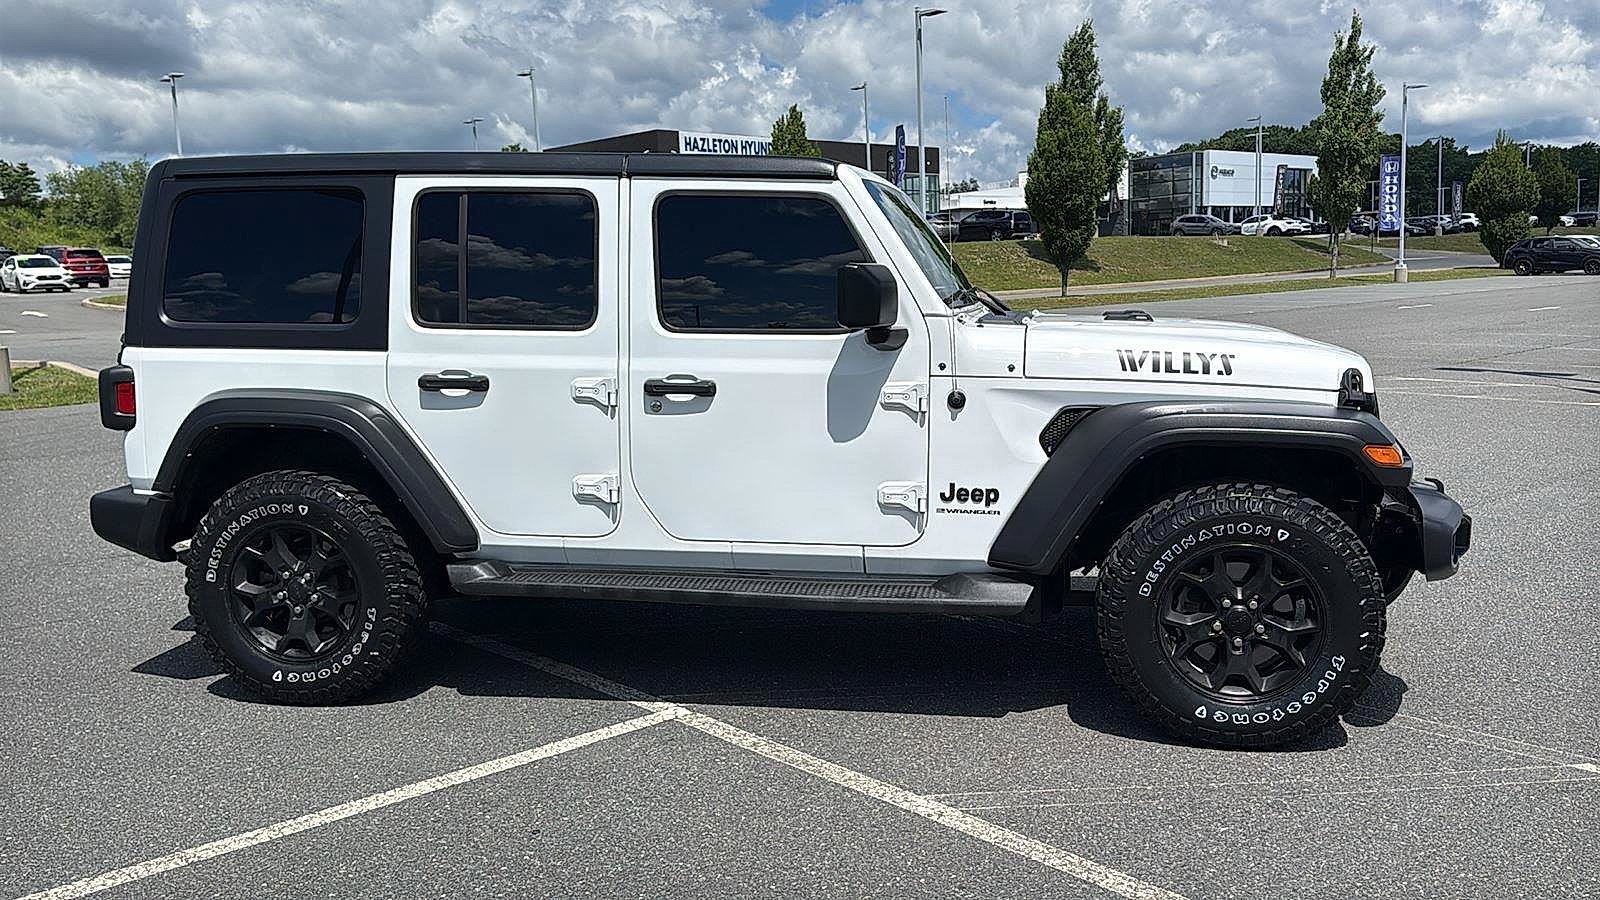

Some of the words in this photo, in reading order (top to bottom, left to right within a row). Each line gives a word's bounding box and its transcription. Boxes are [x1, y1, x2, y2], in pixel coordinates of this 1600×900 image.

[684, 136, 739, 153] HAZLETON
[1384, 175, 1399, 223] HONDA
[1116, 349, 1236, 376] WILLYS
[939, 482, 1000, 508] Jeep
[946, 508, 1001, 516] WRANGLER
[205, 503, 294, 583] DESTINATION
[1138, 522, 1272, 597] DESTINATION
